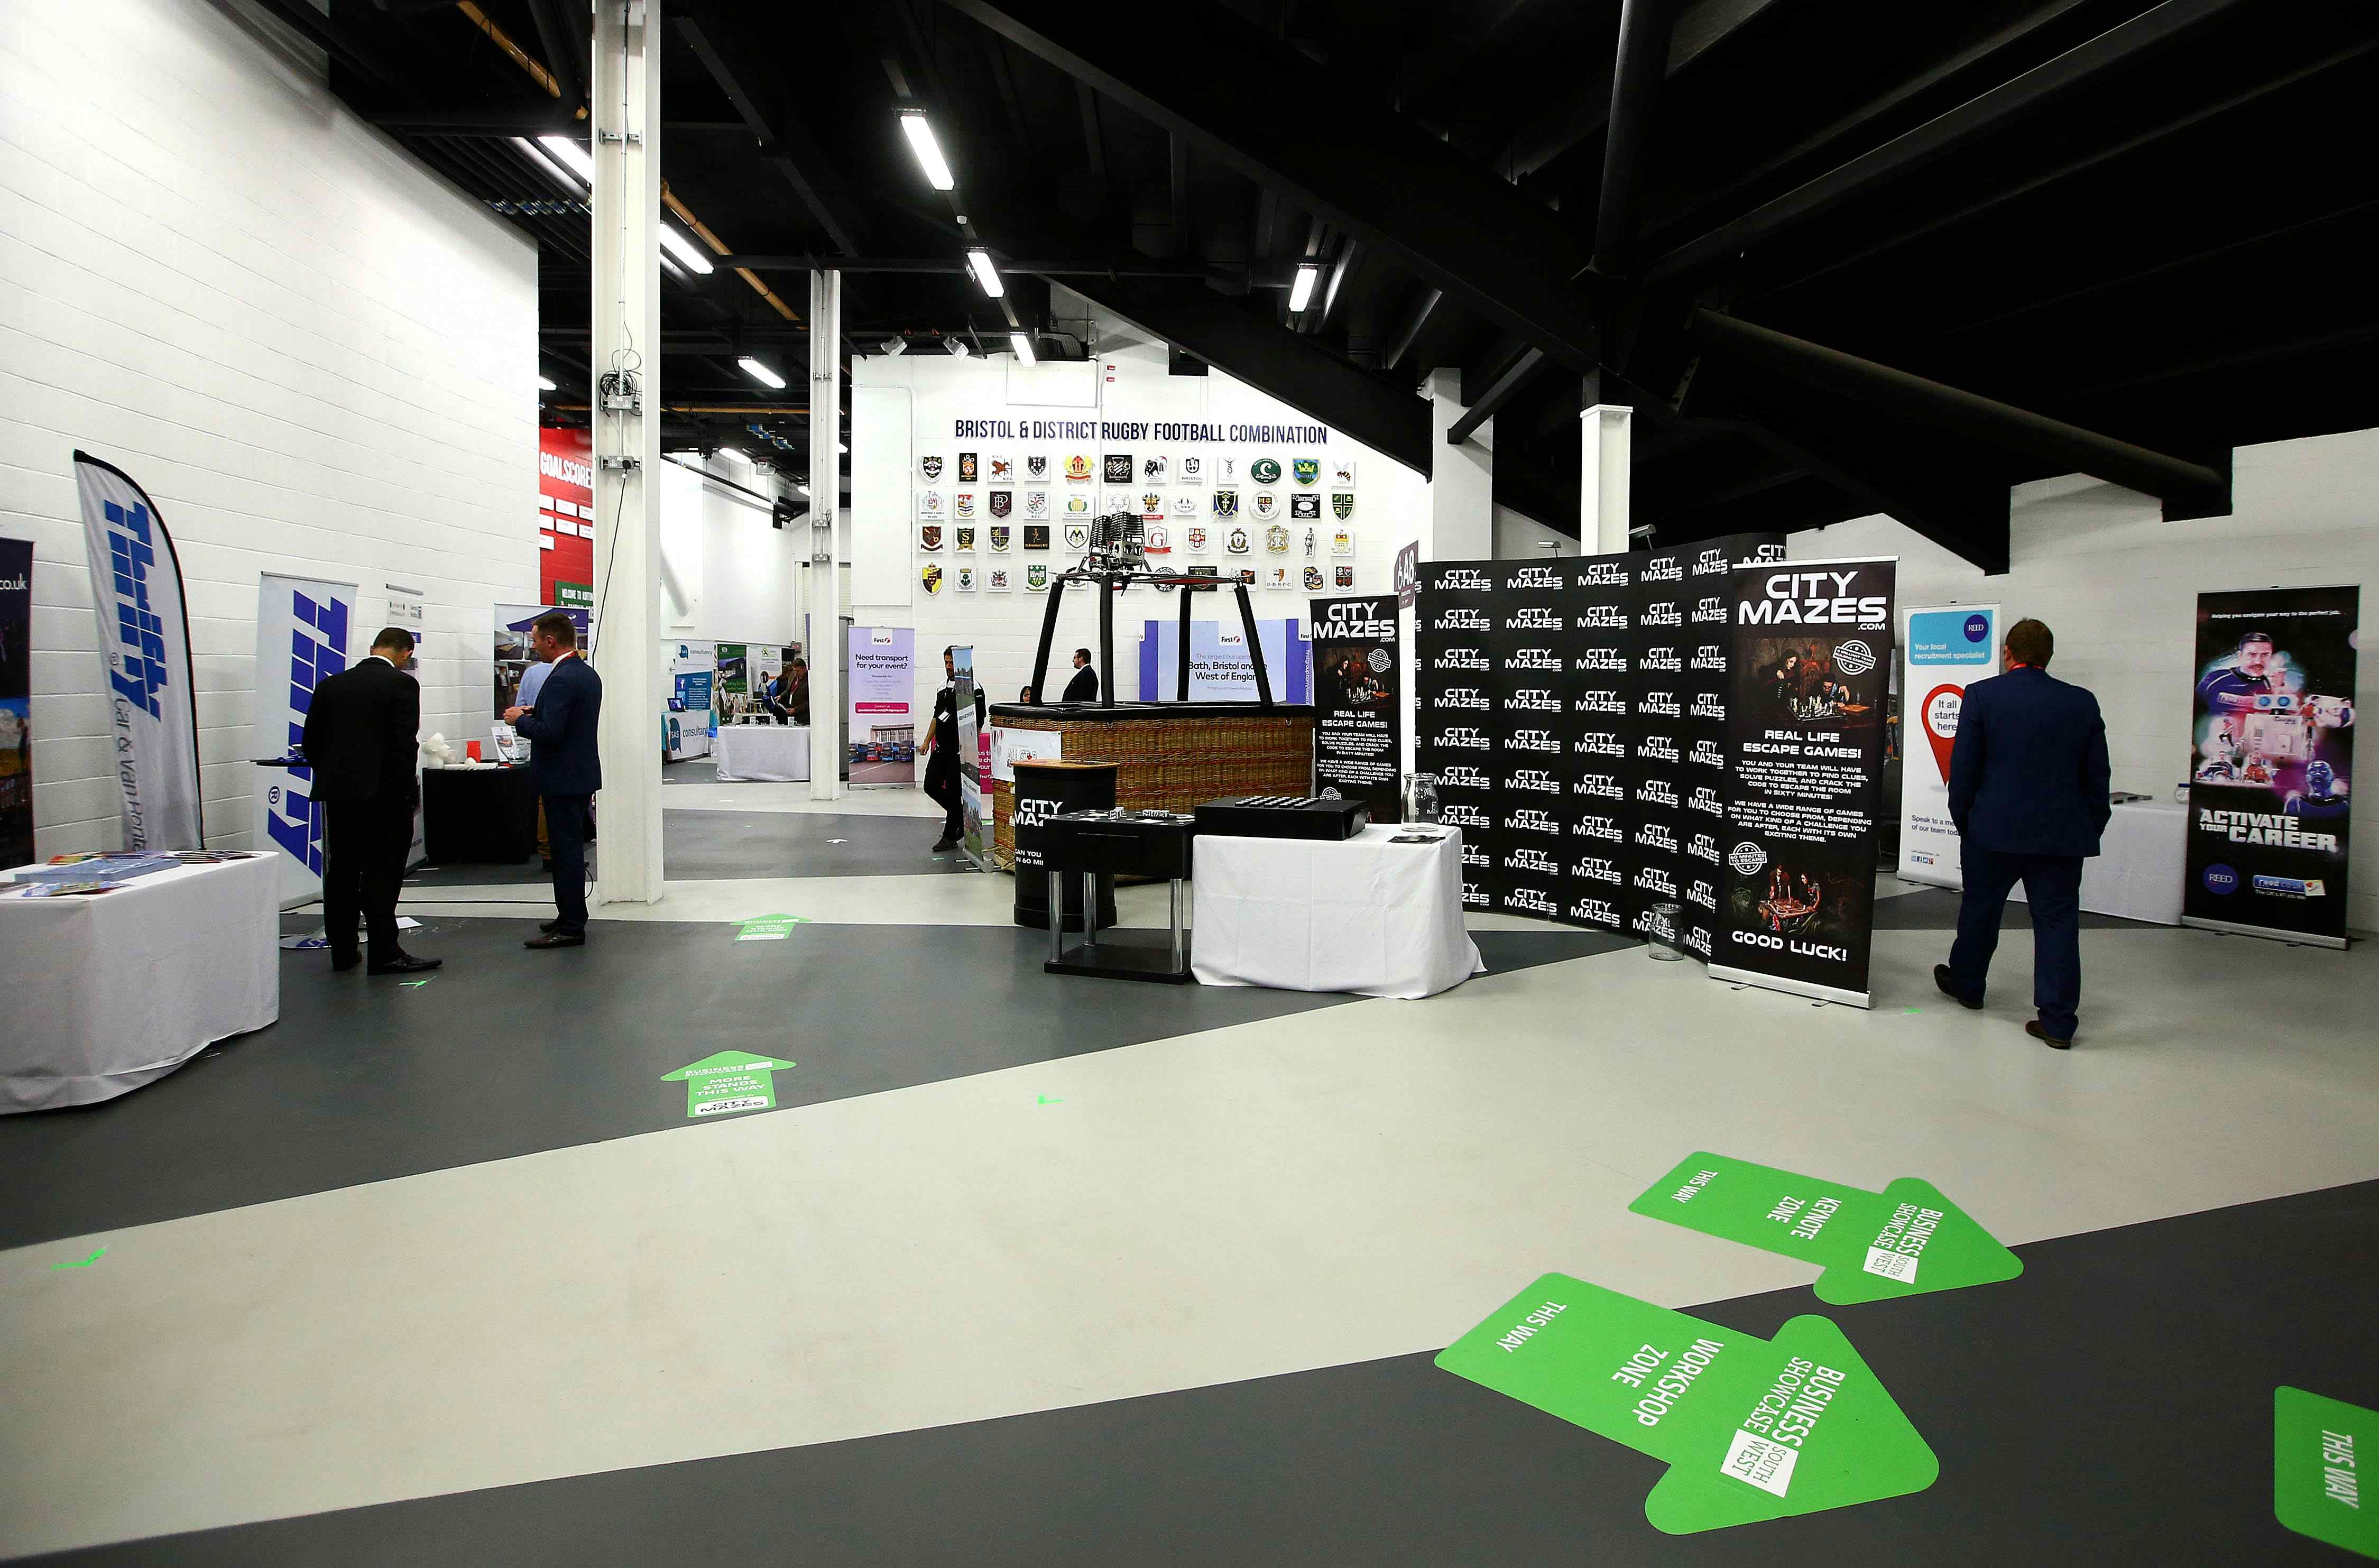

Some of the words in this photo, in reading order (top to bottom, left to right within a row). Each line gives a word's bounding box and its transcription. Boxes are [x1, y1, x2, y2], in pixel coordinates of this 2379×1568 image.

[956, 420, 1015, 439] BRISTOL
[1019, 421, 1029, 438] &
[1034, 421, 1098, 439] DISTRICT
[1102, 423, 1149, 440] RUGBY
[1155, 424, 1225, 441] FOOTBALL
[1230, 425, 1327, 444] COMBINATION
[540, 451, 592, 489] GOALSCORE
[1403, 549, 1415, 587] A8
[1649, 557, 1676, 570] CITY
[1445, 569, 1480, 579] CITY
[1518, 567, 1552, 578] CITY
[1642, 566, 1683, 582] MAZES
[1435, 579, 1491, 589] MAZES
[1507, 577, 1563, 588] MAZES
[1766, 571, 1858, 599] CITY
[104, 499, 168, 722] Thrifty
[1327, 602, 1378, 621] CITY
[1738, 597, 1887, 625] MAZES
[1313, 619, 1395, 639] MAZES
[1189, 662, 1211, 670] Bath,
[1231, 672, 1256, 682] Englan
[1445, 689, 1479, 698] CITY
[1516, 689, 1551, 699] CITY
[1648, 693, 1673, 703] CITY
[1435, 698, 1489, 707] MAZES
[1505, 699, 1561, 709] MAZES
[1639, 702, 1680, 714] MAZES
[1939, 700, 1944, 708] It
[1947, 700, 1957, 708] all
[115, 698, 130, 732] Car
[1935, 711, 1959, 720] starts
[1938, 722, 1957, 731] here
[117, 737, 133, 752] &
[1584, 733, 1615, 743] CITY
[1765, 730, 1803, 741] REAL
[1808, 732, 1840, 743] LIFE
[1575, 742, 1624, 754] MAZES
[1743, 743, 1799, 754] ESCAPE
[1804, 746, 1861, 758] GAMES!
[1020, 799, 1063, 815] CITY
[1015, 811, 1058, 826] MAZ
[2199, 809, 2299, 831] ACTIVATE
[2199, 823, 2227, 833] YOUR
[2229, 826, 2338, 853] CAREER
[1515, 849, 1547, 861] CITY
[1505, 857, 1557, 872] MAZES
[2209, 873, 2233, 883] REED
[1732, 930, 1783, 949] GOOD
[1790, 939, 1847, 962] LUCK!
[702, 1080, 758, 1090] STANDS
[709, 1075, 751, 1084] MORE
[695, 1087, 729, 1096] THIS
[1689, 1170, 1718, 1187] THIS
[1671, 1185, 1701, 1204] WAY
[1766, 1196, 1805, 1223] ZONE
[1790, 1196, 1842, 1240] KEYNOTE
[1874, 1203, 1917, 1249] SHOWCASE
[1896, 1208, 1943, 1256] BUSINESS
[1871, 1252, 1895, 1272] WEST
[1888, 1256, 1910, 1277] SOUTH
[1526, 1300, 1567, 1327] THIS
[1496, 1324, 1538, 1353] WAY
[1611, 1344, 1669, 1388] ZONE
[1632, 1338, 1725, 1427] WORKSHOP
[1743, 1357, 1813, 1434] SHOWCASE
[1772, 1366, 1846, 1447] BUSINESS
[2321, 1429, 2356, 1469] THIS
[1732, 1441, 1769, 1476] WEST
[1753, 1446, 1787, 1483] SOUTH
[2324, 1466, 2359, 1509] WAY
